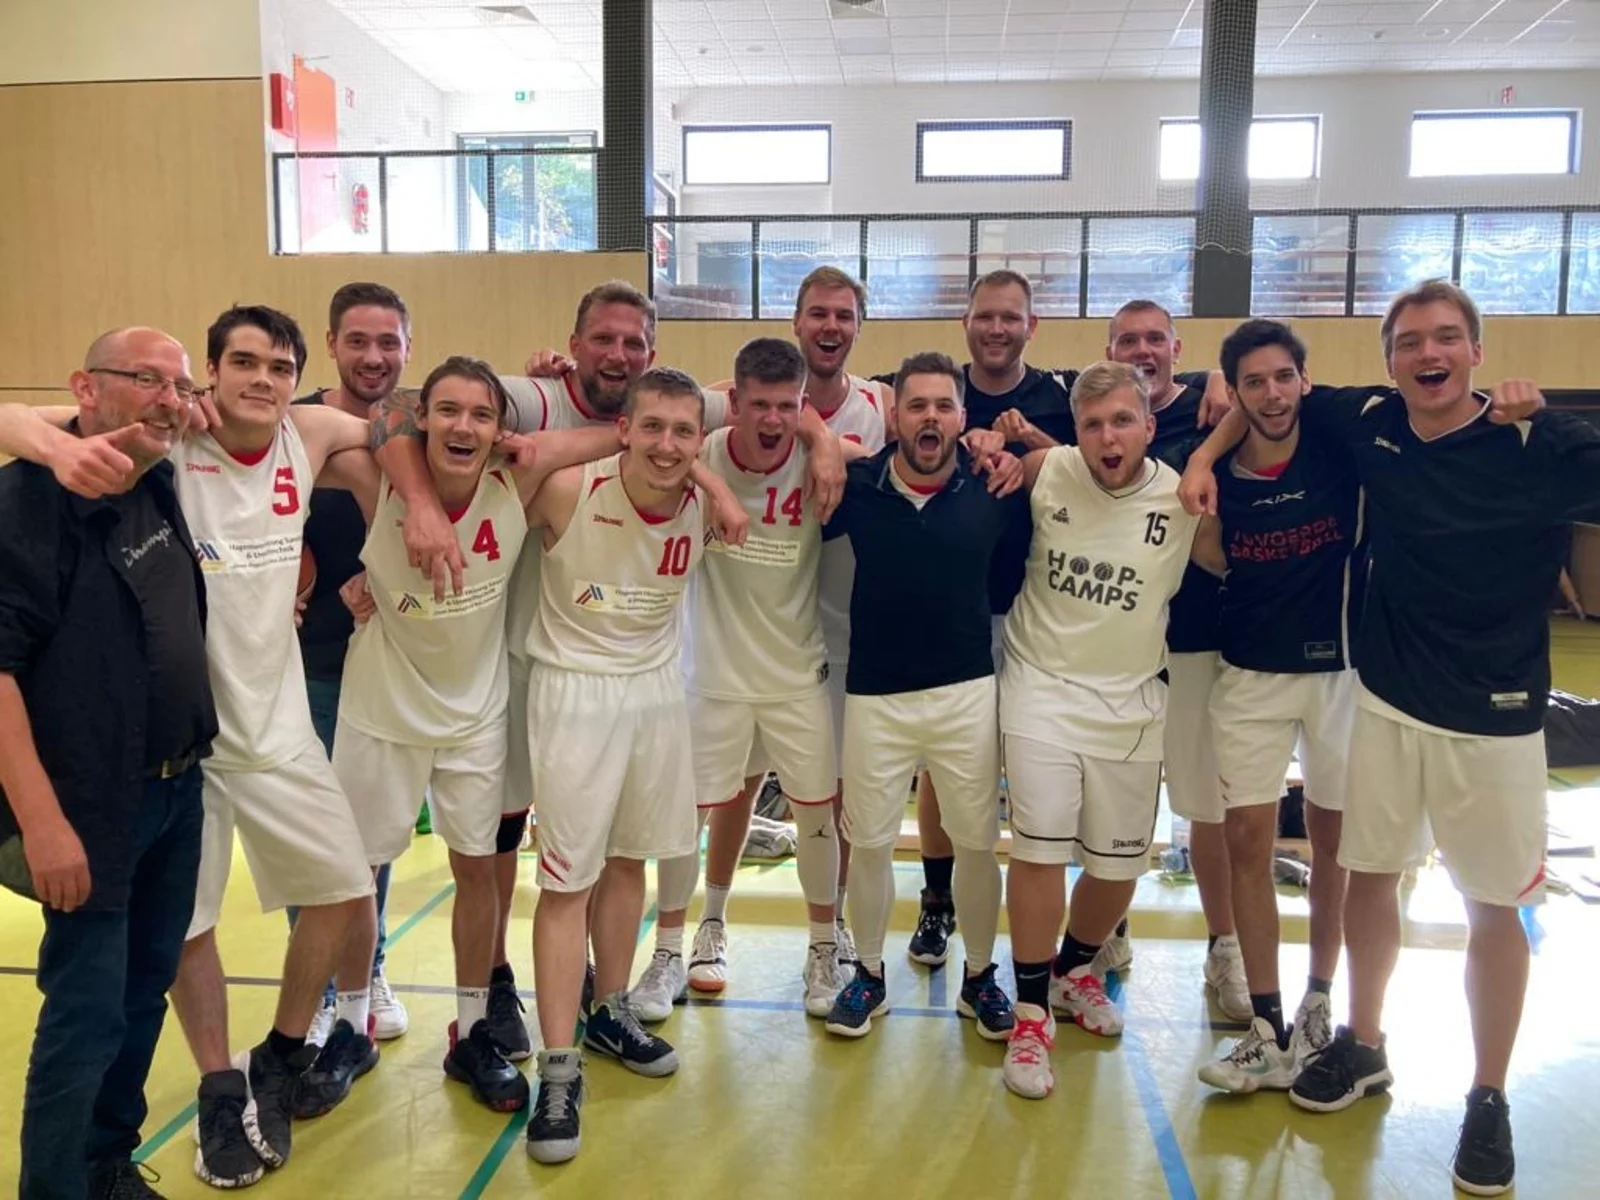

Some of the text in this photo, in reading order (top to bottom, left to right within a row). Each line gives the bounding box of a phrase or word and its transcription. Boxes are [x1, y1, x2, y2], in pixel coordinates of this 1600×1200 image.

[272, 466, 300, 516] 5
[762, 486, 802, 527] 14
[471, 518, 501, 562] 4
[1144, 511, 1171, 546] 15
[656, 535, 691, 576] 10
[1048, 569, 1138, 612] CAMPS
